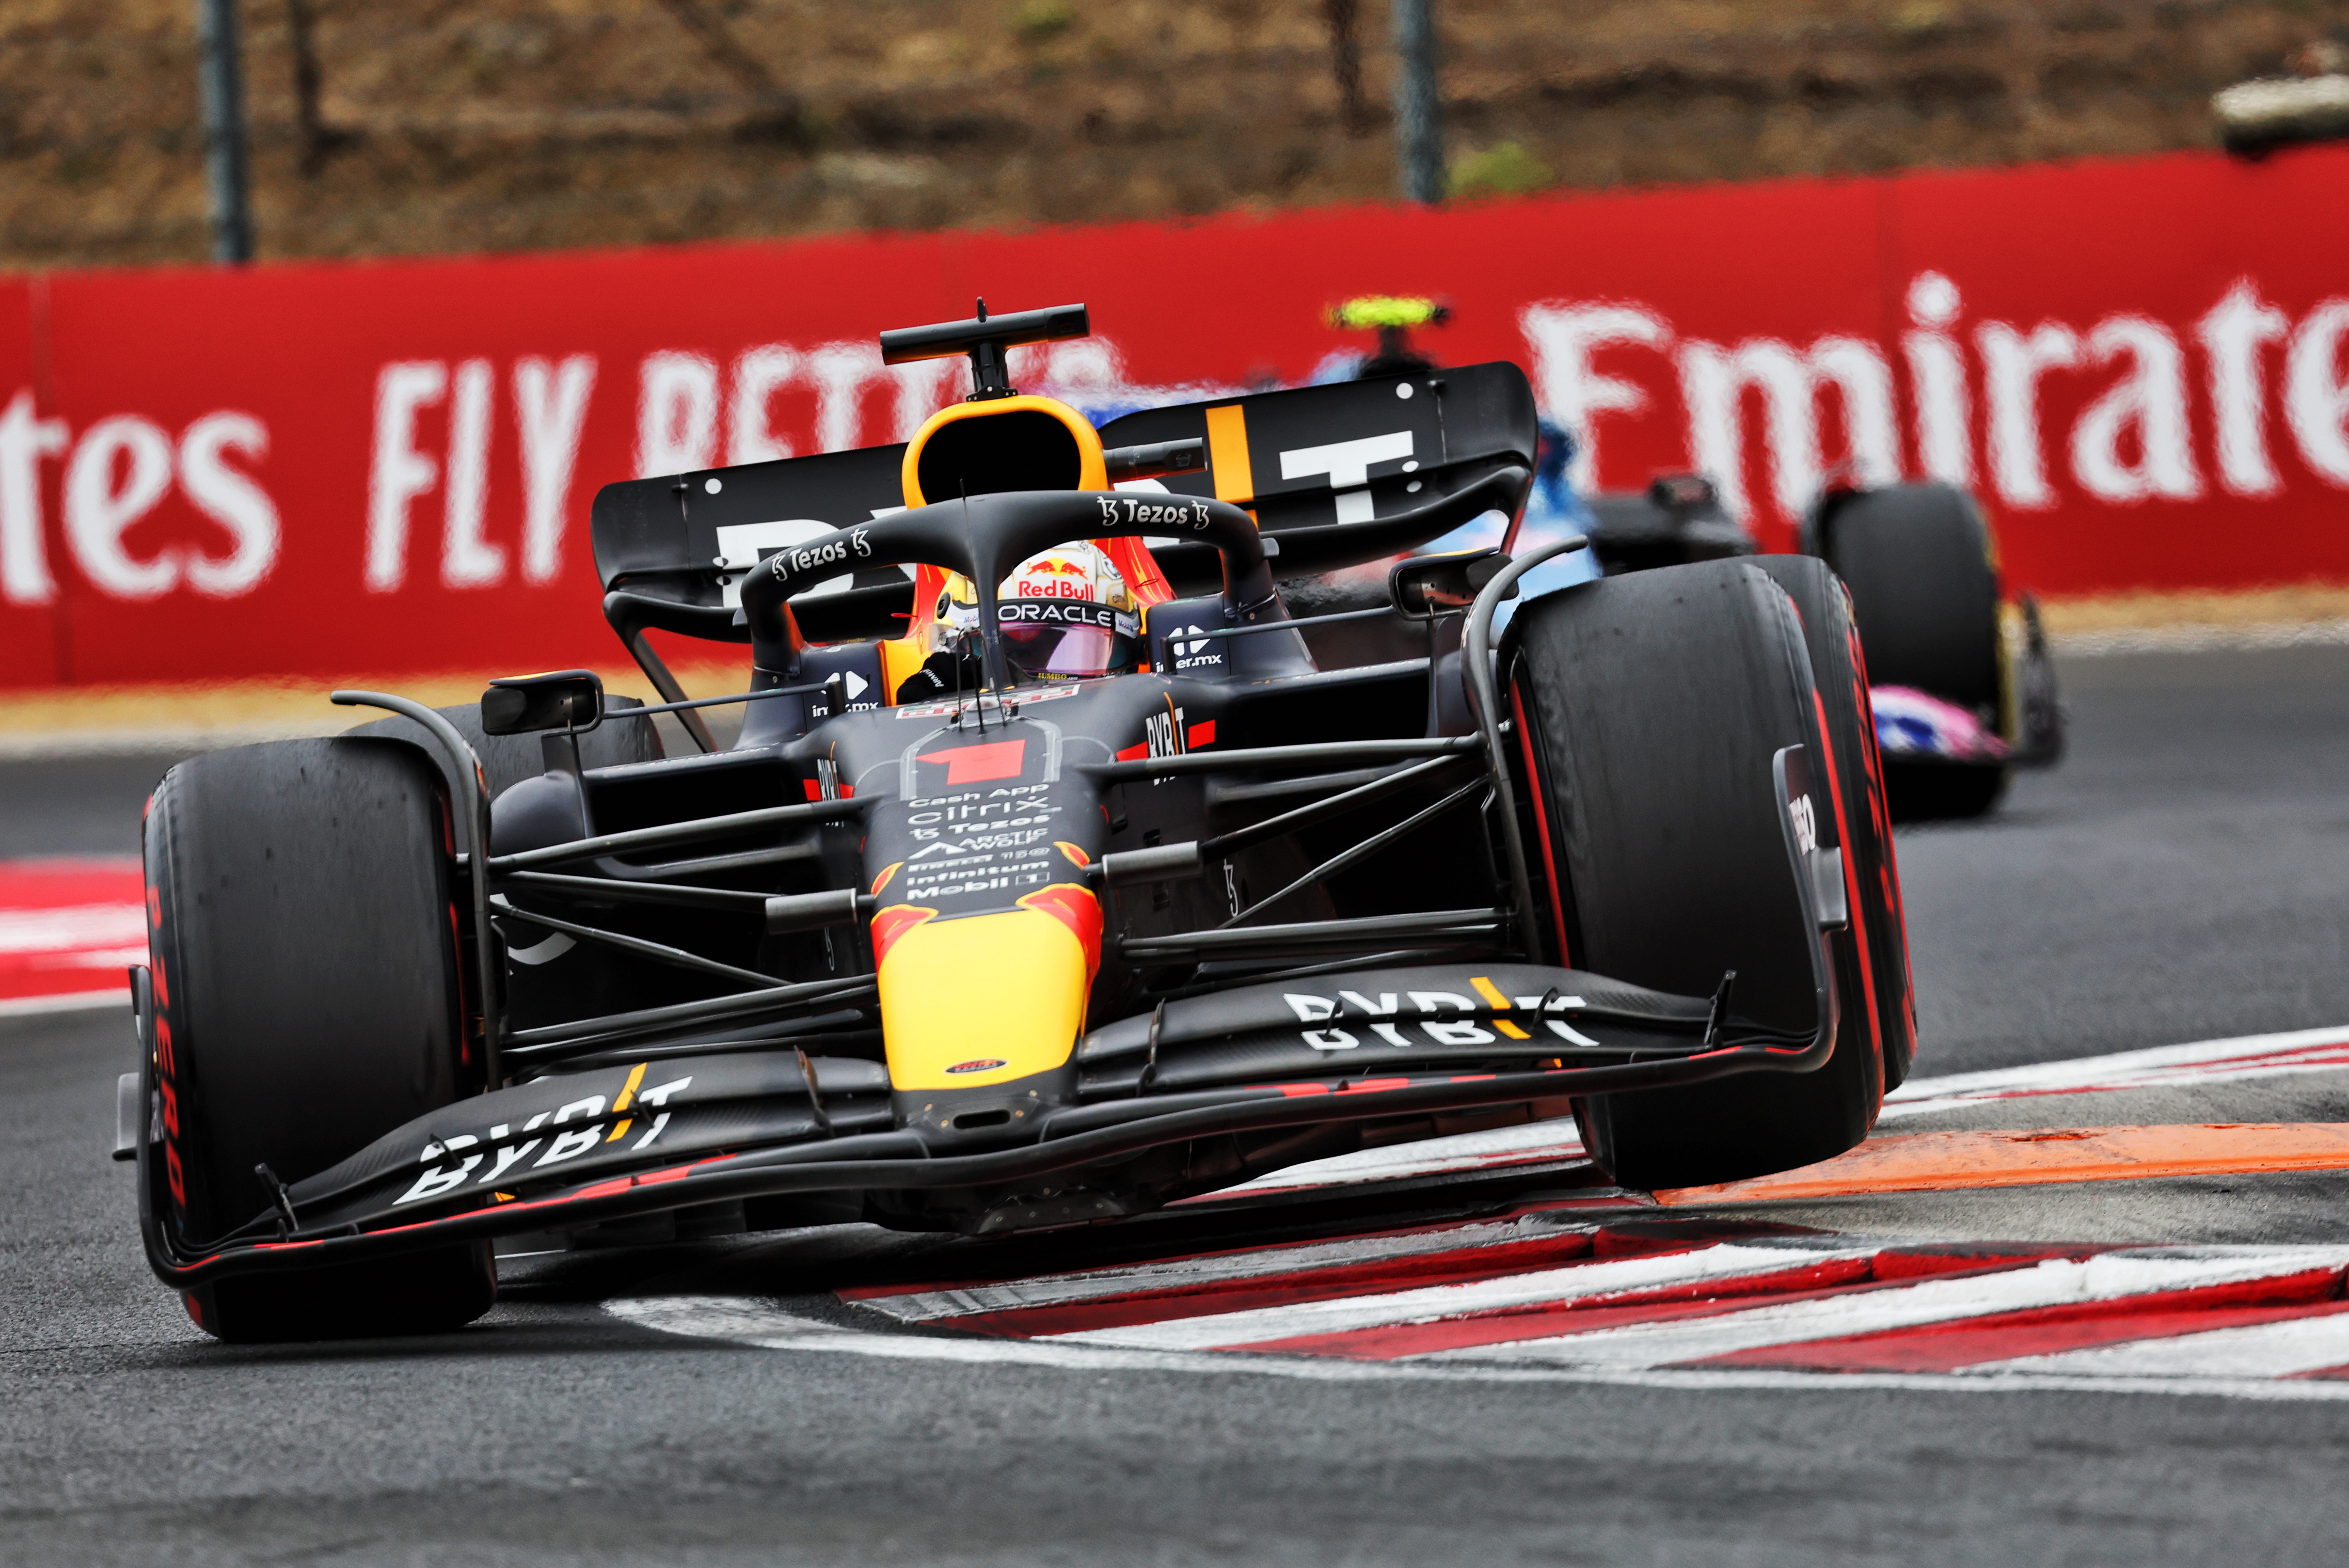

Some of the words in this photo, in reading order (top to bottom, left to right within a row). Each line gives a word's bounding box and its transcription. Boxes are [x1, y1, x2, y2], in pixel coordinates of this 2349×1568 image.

[365, 353, 599, 593] FLY
[1123, 499, 1188, 525] Tezos
[789, 540, 847, 572] Tezos
[1019, 580, 1056, 597] Red
[1061, 581, 1094, 602] Bull
[998, 604, 1112, 627] ORACLE
[915, 739, 1026, 786] 1
[908, 792, 981, 808] Cash
[988, 784, 1050, 798] App
[907, 796, 1049, 825] Citrix
[947, 815, 1051, 835] Tezos
[959, 828, 1048, 847] ARCTIC
[971, 835, 1040, 851] WOLF
[907, 861, 1050, 886] infinitum
[907, 877, 1009, 901] Mobil
[1283, 976, 1600, 1051] BYBIT
[392, 1062, 693, 1206] BYBIT
